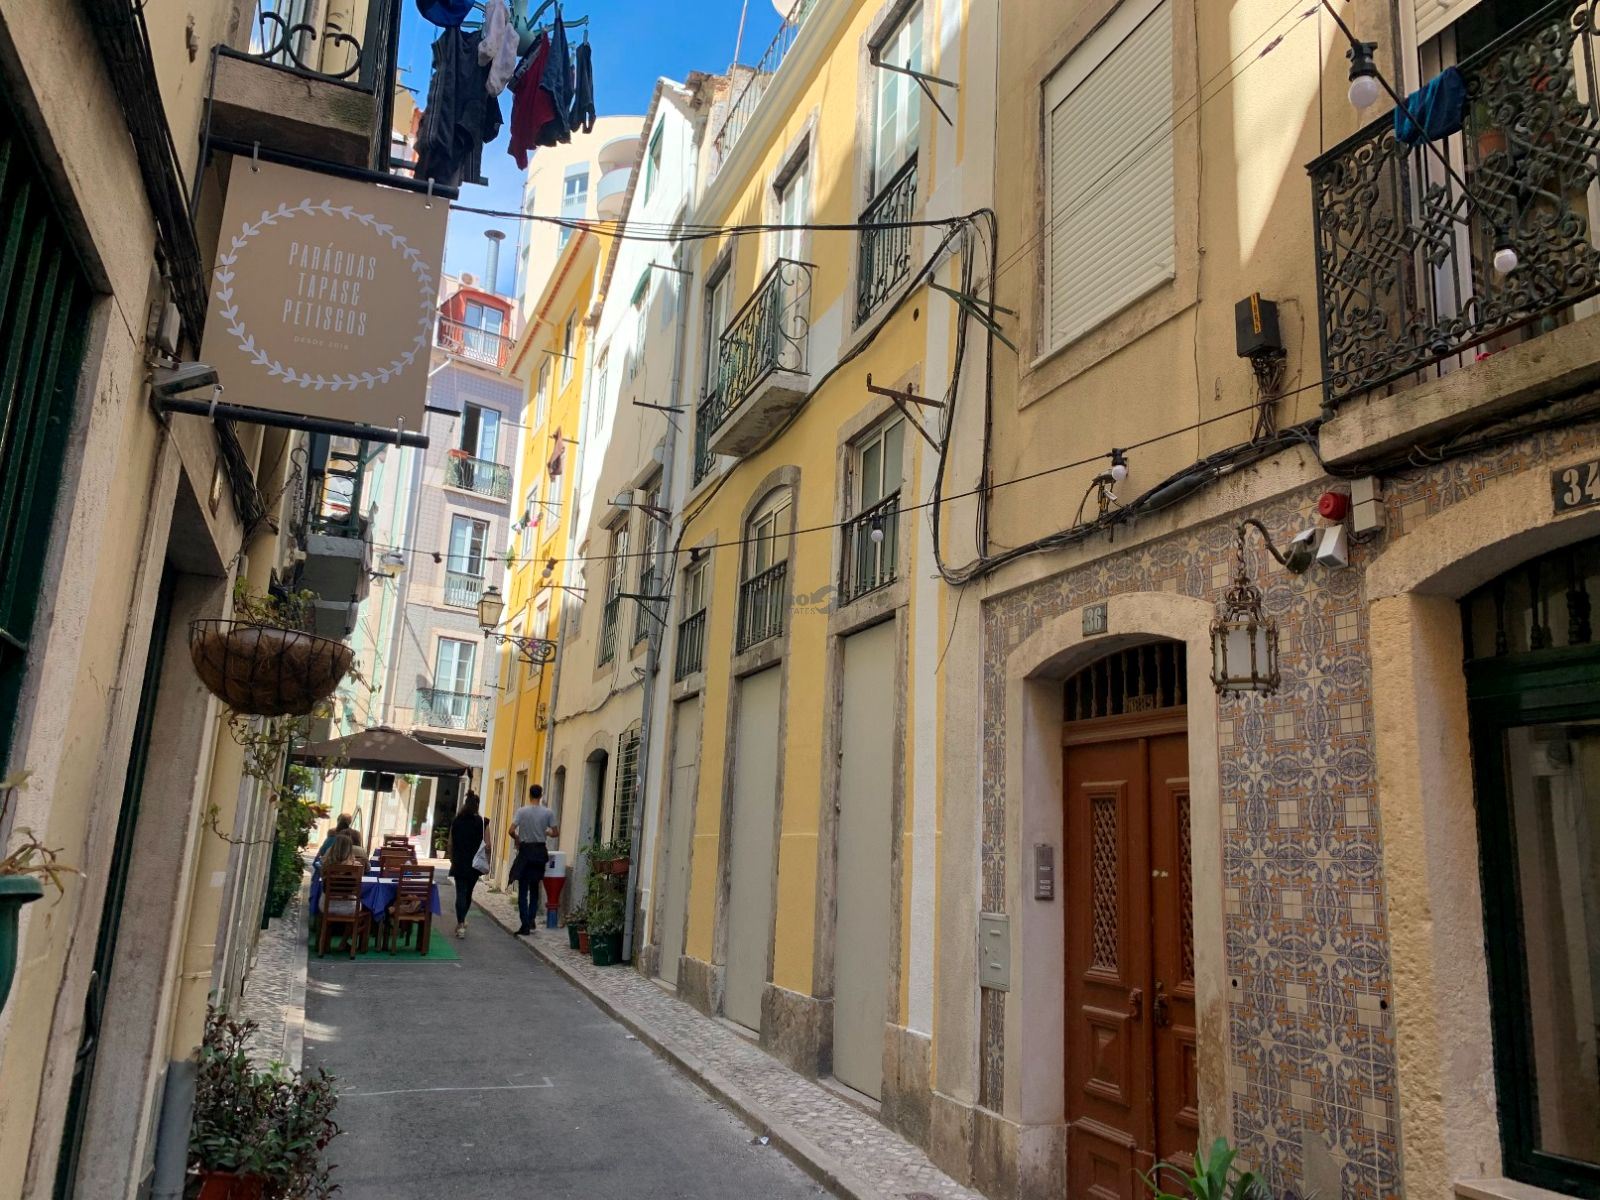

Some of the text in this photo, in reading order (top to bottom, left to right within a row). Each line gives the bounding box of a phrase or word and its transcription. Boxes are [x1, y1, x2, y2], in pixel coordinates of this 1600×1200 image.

[289, 242, 376, 280] PARÁGUAS
[282, 299, 367, 336] PETISCOS
[1086, 607, 1102, 632] 36
